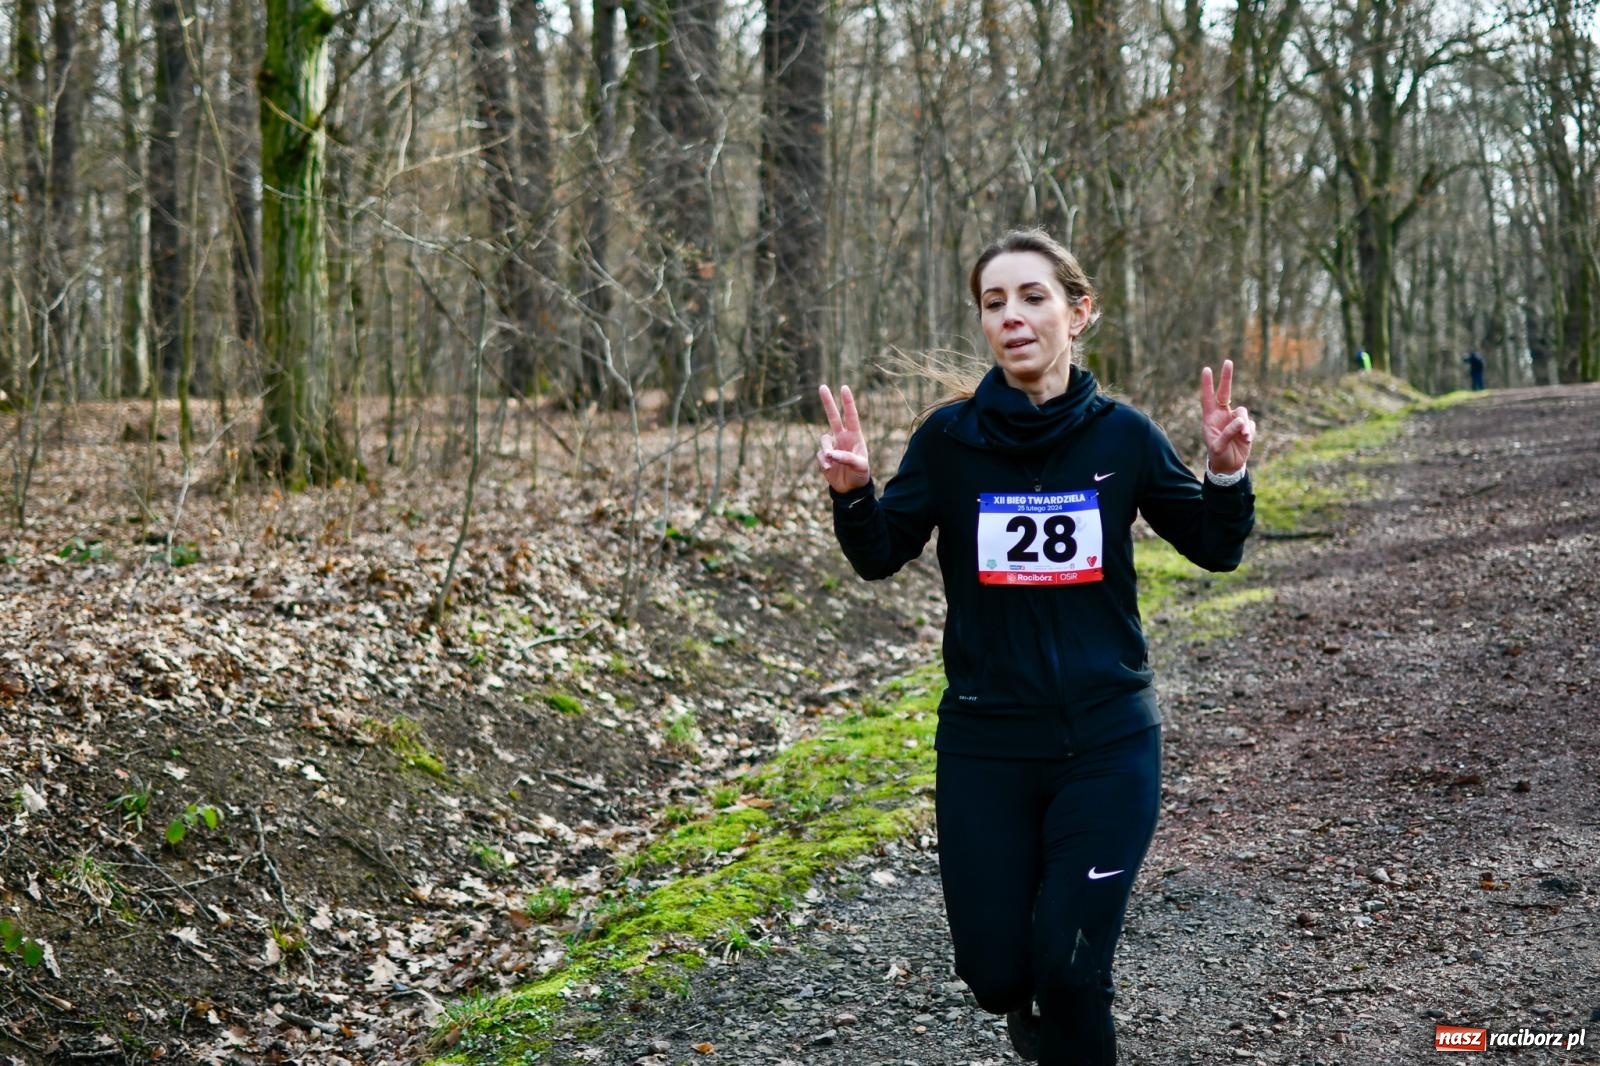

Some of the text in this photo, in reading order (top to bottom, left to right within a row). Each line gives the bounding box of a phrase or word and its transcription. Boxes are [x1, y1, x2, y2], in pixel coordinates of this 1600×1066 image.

[993, 493, 1086, 505] XII BIEG TWARDZIELA
[1026, 505, 1046, 513] lutego
[1006, 515, 1078, 563] 28
[1017, 573, 1053, 582] Racibórz
